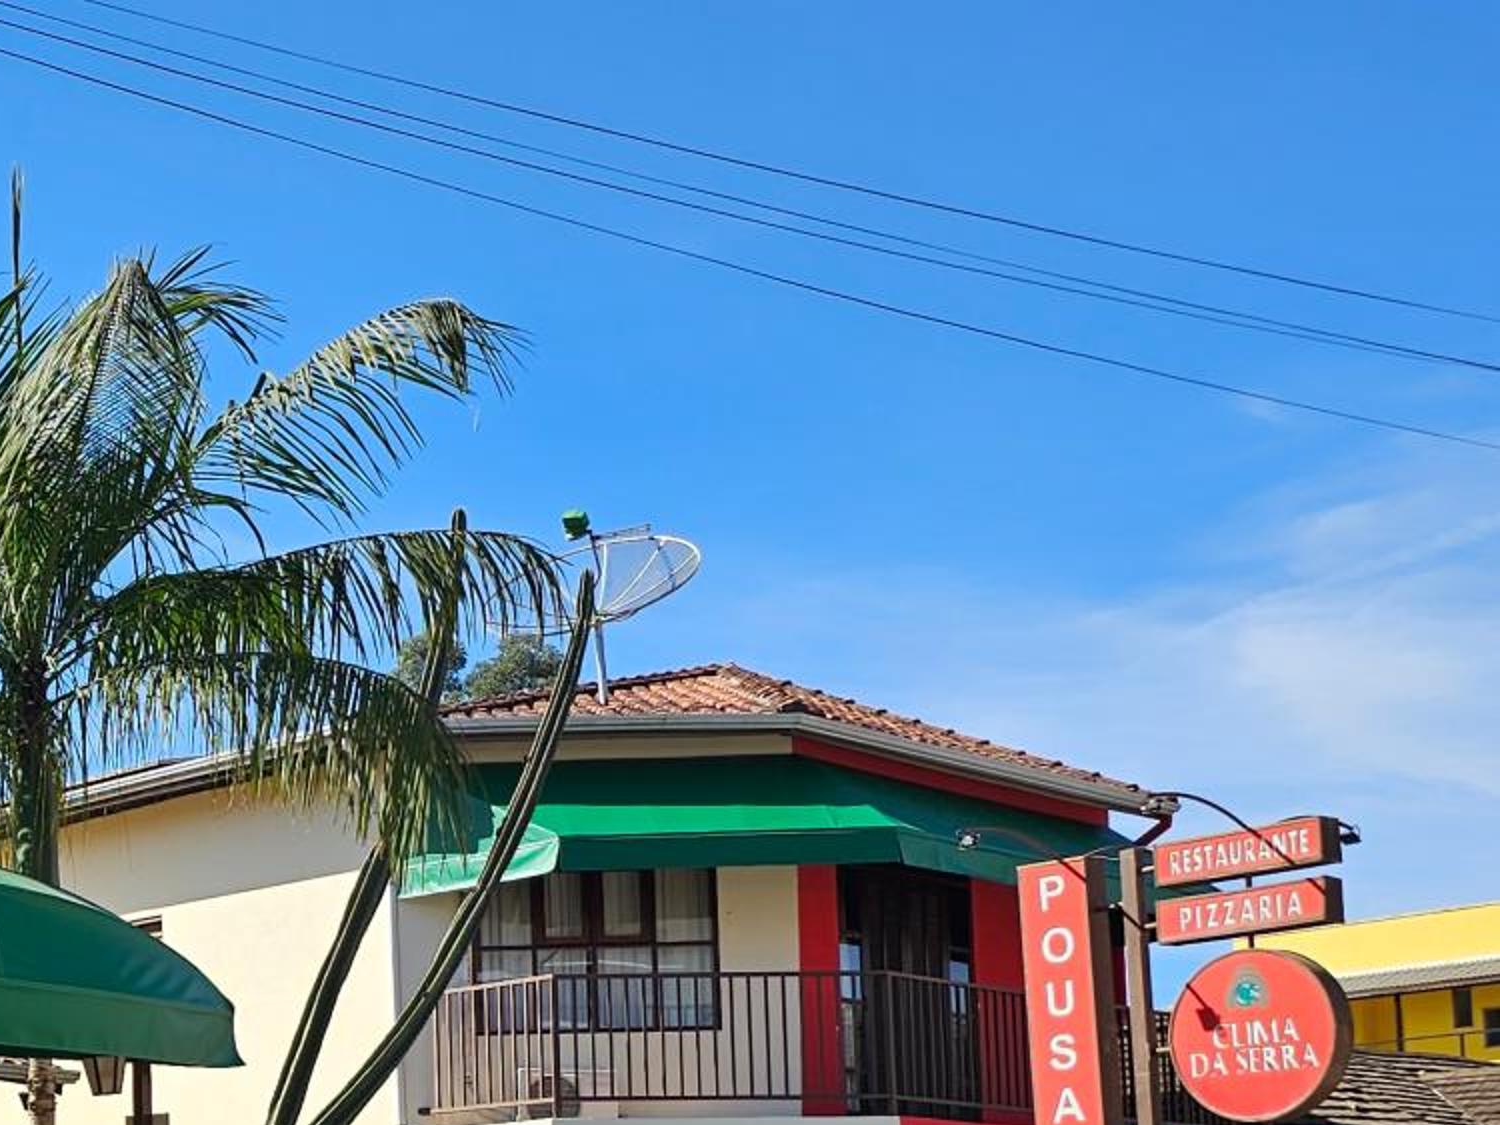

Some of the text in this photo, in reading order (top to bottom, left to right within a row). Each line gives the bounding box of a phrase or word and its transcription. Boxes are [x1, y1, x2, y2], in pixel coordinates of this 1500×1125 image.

[1169, 829, 1309, 876] RESTAURANTE
[1179, 891, 1303, 931] PIZZARIA
[1211, 1017, 1299, 1050] CLIMA
[1189, 1042, 1320, 1079] DA SERRA
